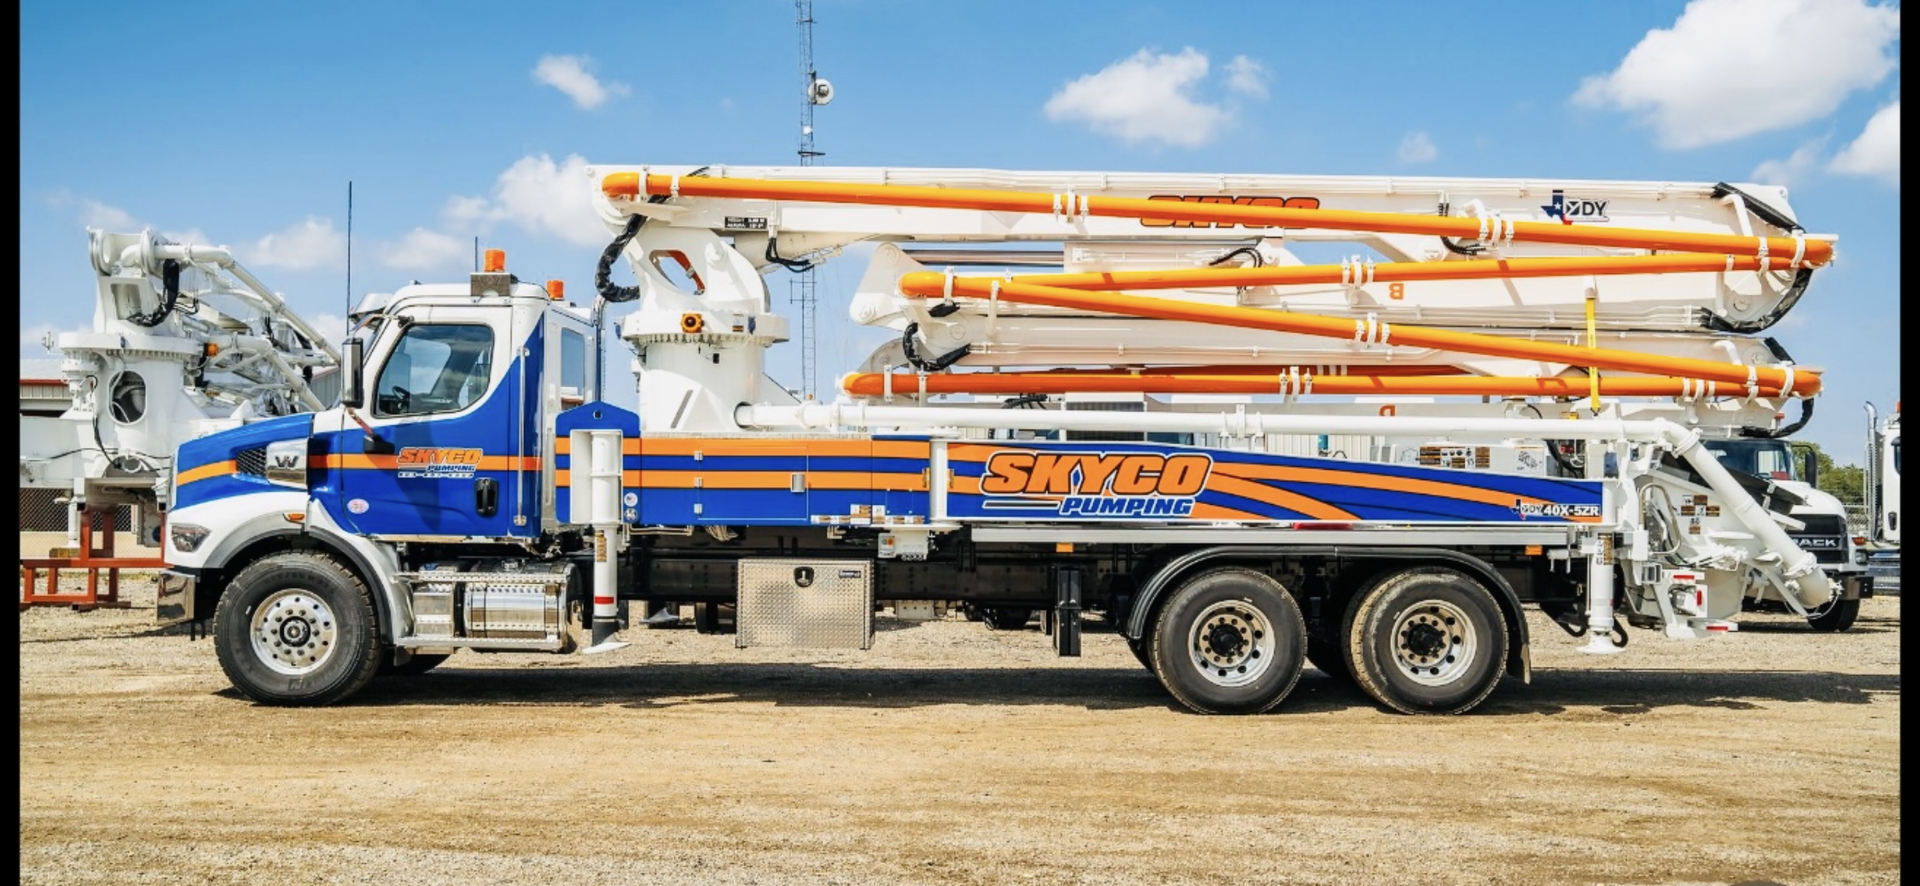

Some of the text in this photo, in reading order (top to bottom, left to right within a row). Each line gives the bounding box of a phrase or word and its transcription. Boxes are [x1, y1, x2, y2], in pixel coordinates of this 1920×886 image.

[1389, 283, 1404, 300] B
[398, 448, 482, 464] SKYCO
[981, 452, 1212, 496] SKYCO
[1061, 497, 1194, 515] PUMPING
[1544, 505, 1600, 516] 40X-5ZR
